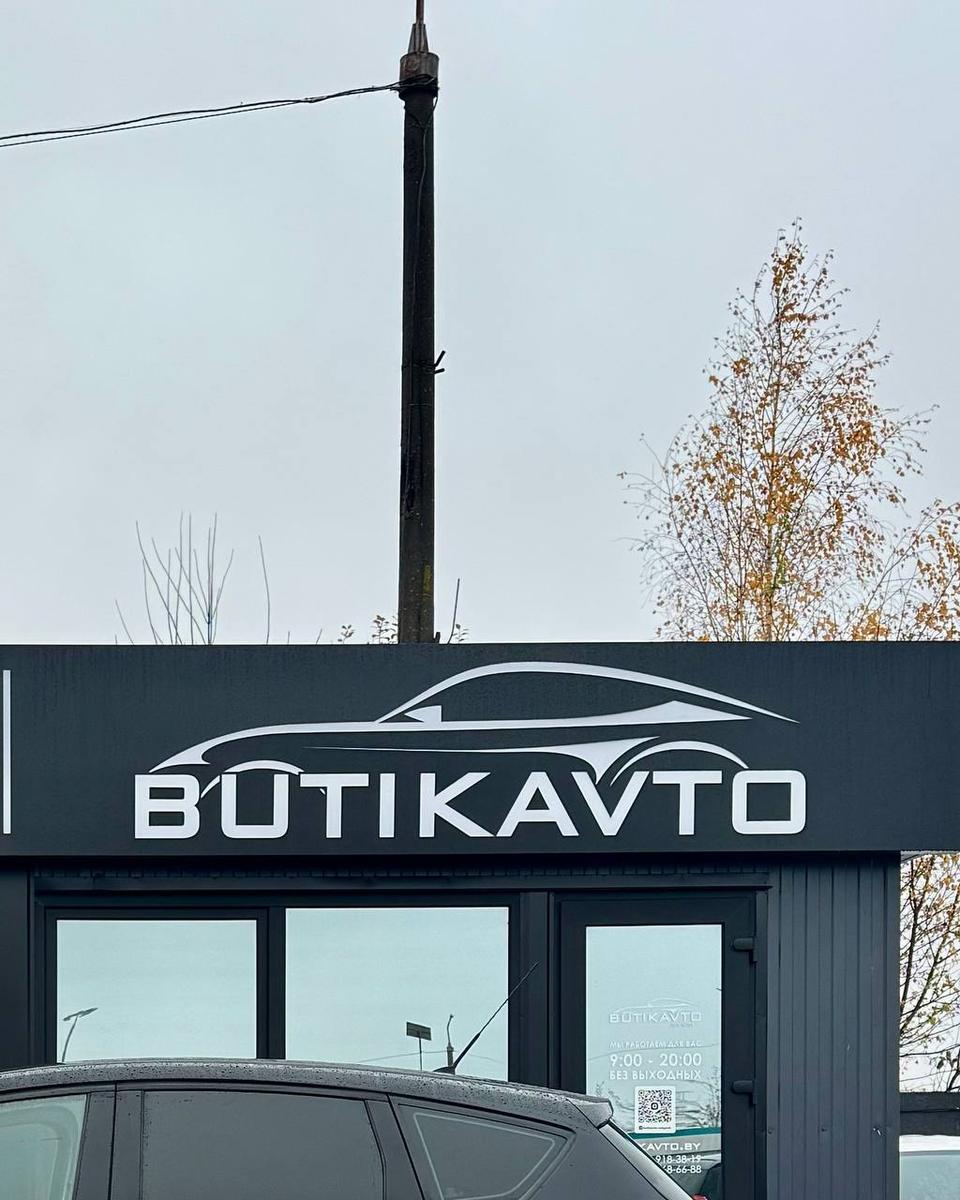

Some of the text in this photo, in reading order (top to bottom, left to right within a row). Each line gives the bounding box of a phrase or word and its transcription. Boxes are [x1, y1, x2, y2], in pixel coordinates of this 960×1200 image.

[134, 769, 807, 839] BUTIKAVTO
[609, 1012, 702, 1023] BUTIKAVTO
[610, 1053, 642, 1067] 9:00
[659, 1053, 702, 1067] 20:00
[609, 1069, 701, 1080] БЕЗ ВЫХОДНЫХ
